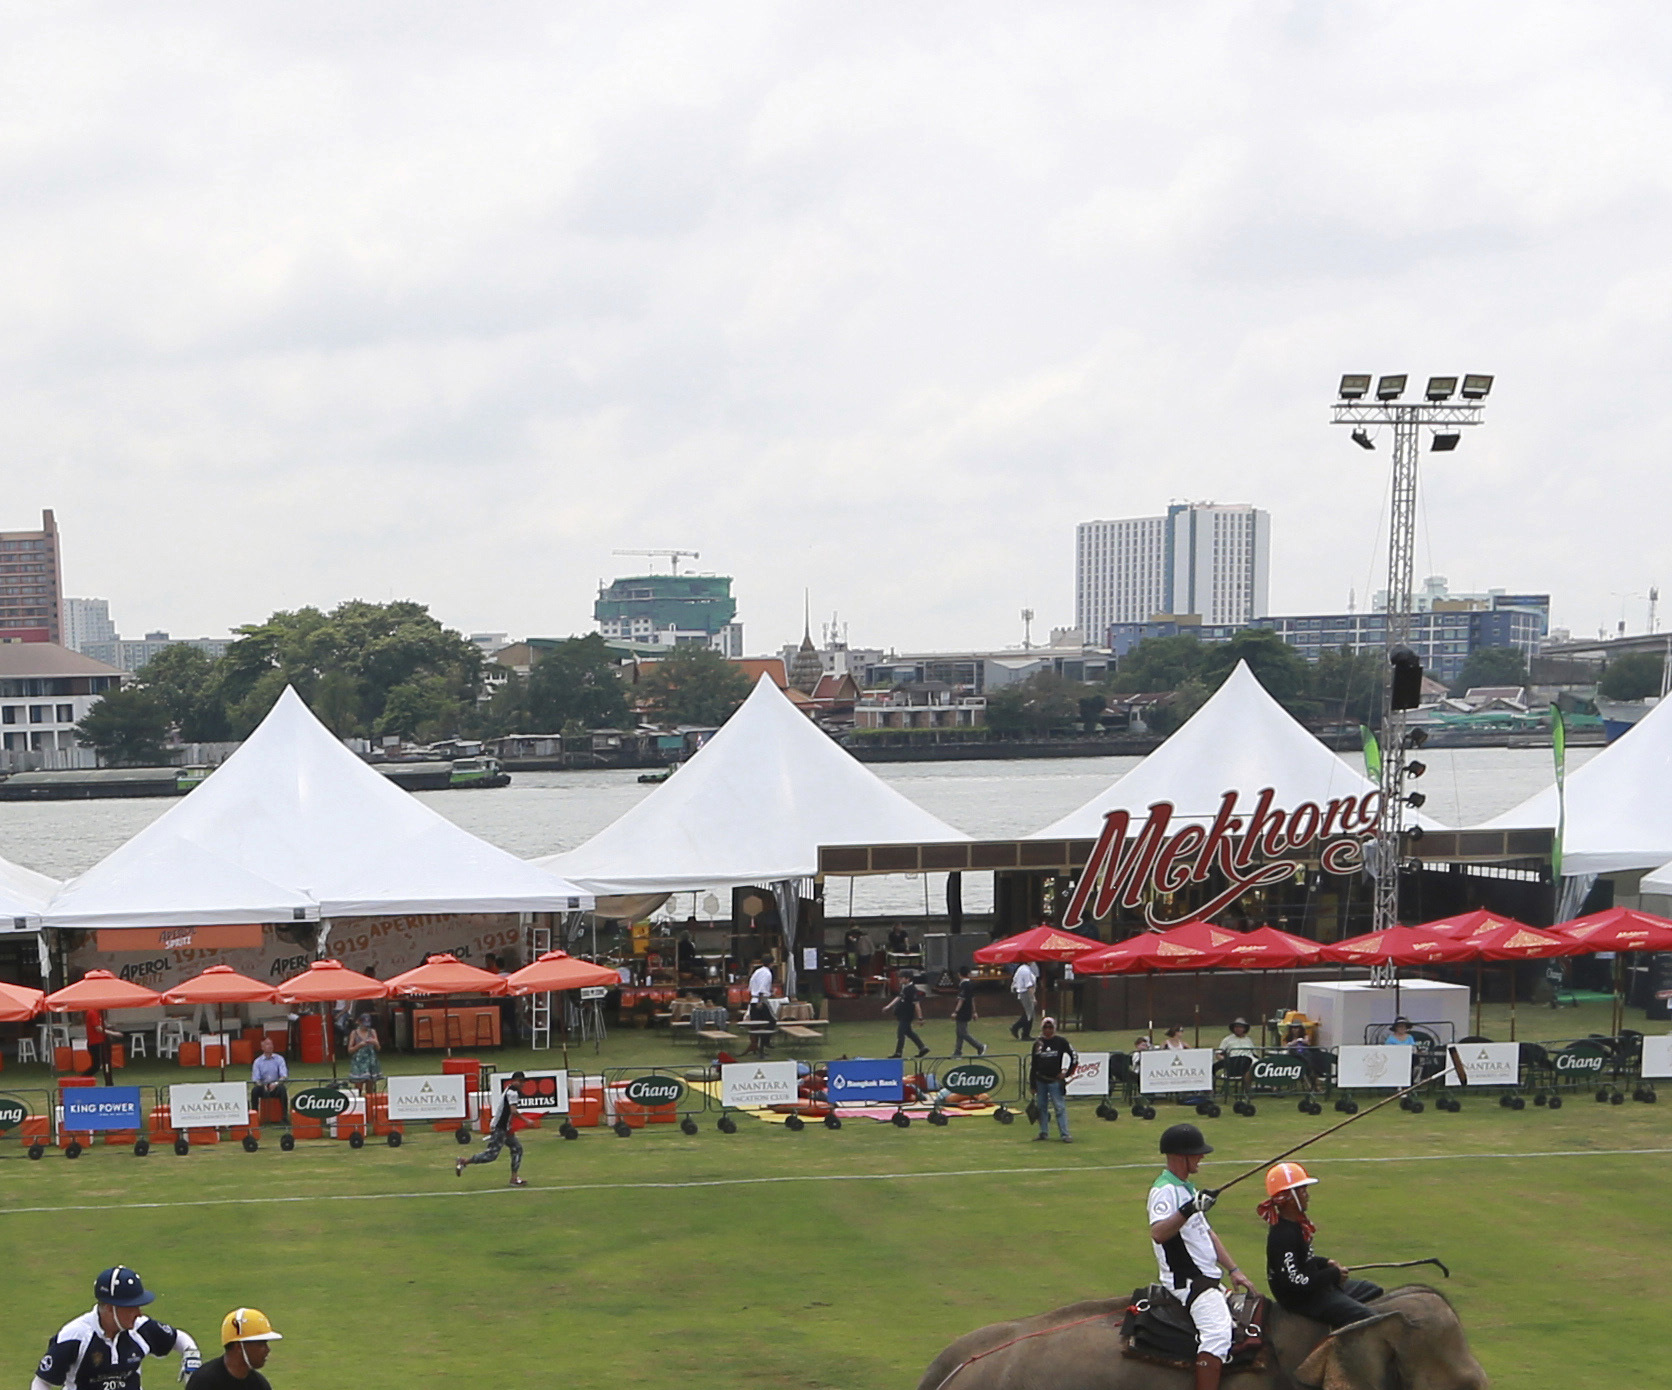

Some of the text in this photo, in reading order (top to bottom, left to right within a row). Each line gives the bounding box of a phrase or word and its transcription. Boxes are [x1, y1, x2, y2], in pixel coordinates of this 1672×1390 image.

[1061, 787, 1384, 933] Mekhong
[158, 927, 198, 943] APEROL
[164, 935, 192, 949] SPRITZ
[120, 957, 172, 981] APEROL
[1464, 1061, 1511, 1072] NANTARA
[1557, 1054, 1603, 1070] Chang
[1148, 1068, 1205, 1079] ANANTARA
[1254, 1063, 1302, 1080] Chang
[731, 1081, 789, 1091] ANANTARA
[847, 1079, 897, 1088] Bangkok Bank
[946, 1072, 996, 1090] Chang
[629, 1082, 678, 1100] Chang
[295, 1094, 345, 1112] Chang
[397, 1094, 457, 1105] ANANTARA
[70, 1103, 135, 1113] KING POWER
[180, 1102, 240, 1113] ANANTARA
